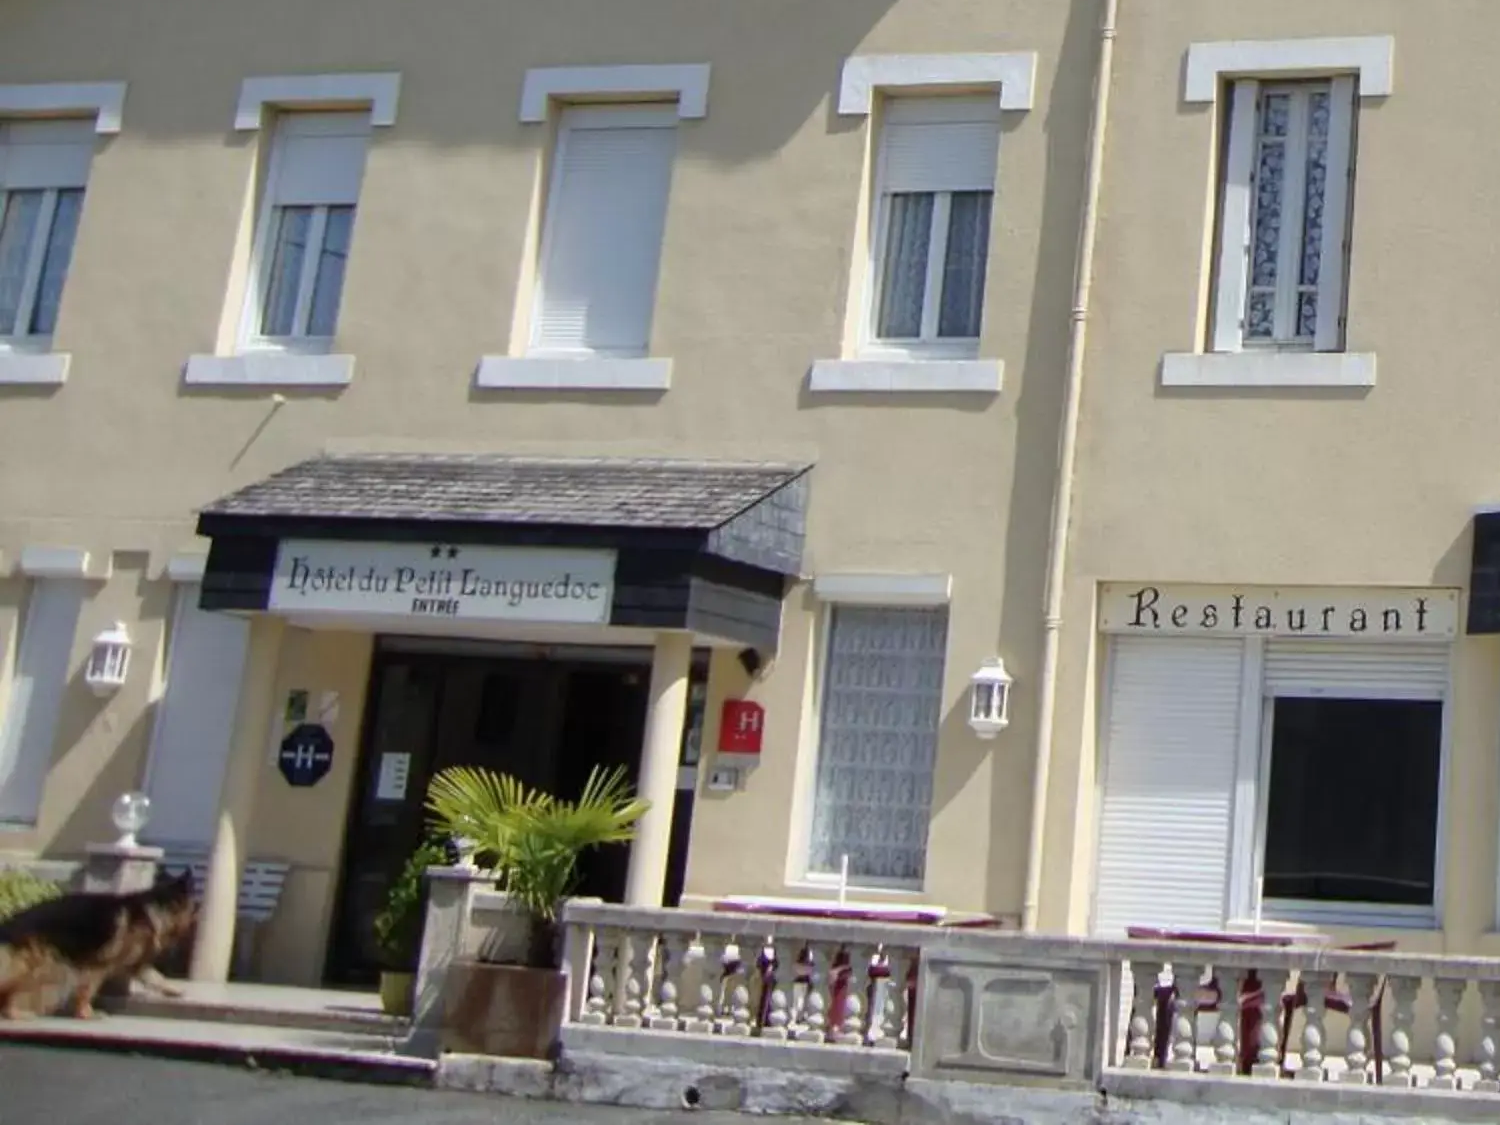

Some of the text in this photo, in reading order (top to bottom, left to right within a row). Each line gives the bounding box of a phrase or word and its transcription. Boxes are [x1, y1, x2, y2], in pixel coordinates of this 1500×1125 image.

[287, 555, 600, 607] Hôtel du Petit Languedoc
[1127, 586, 1429, 631] Restaurant
